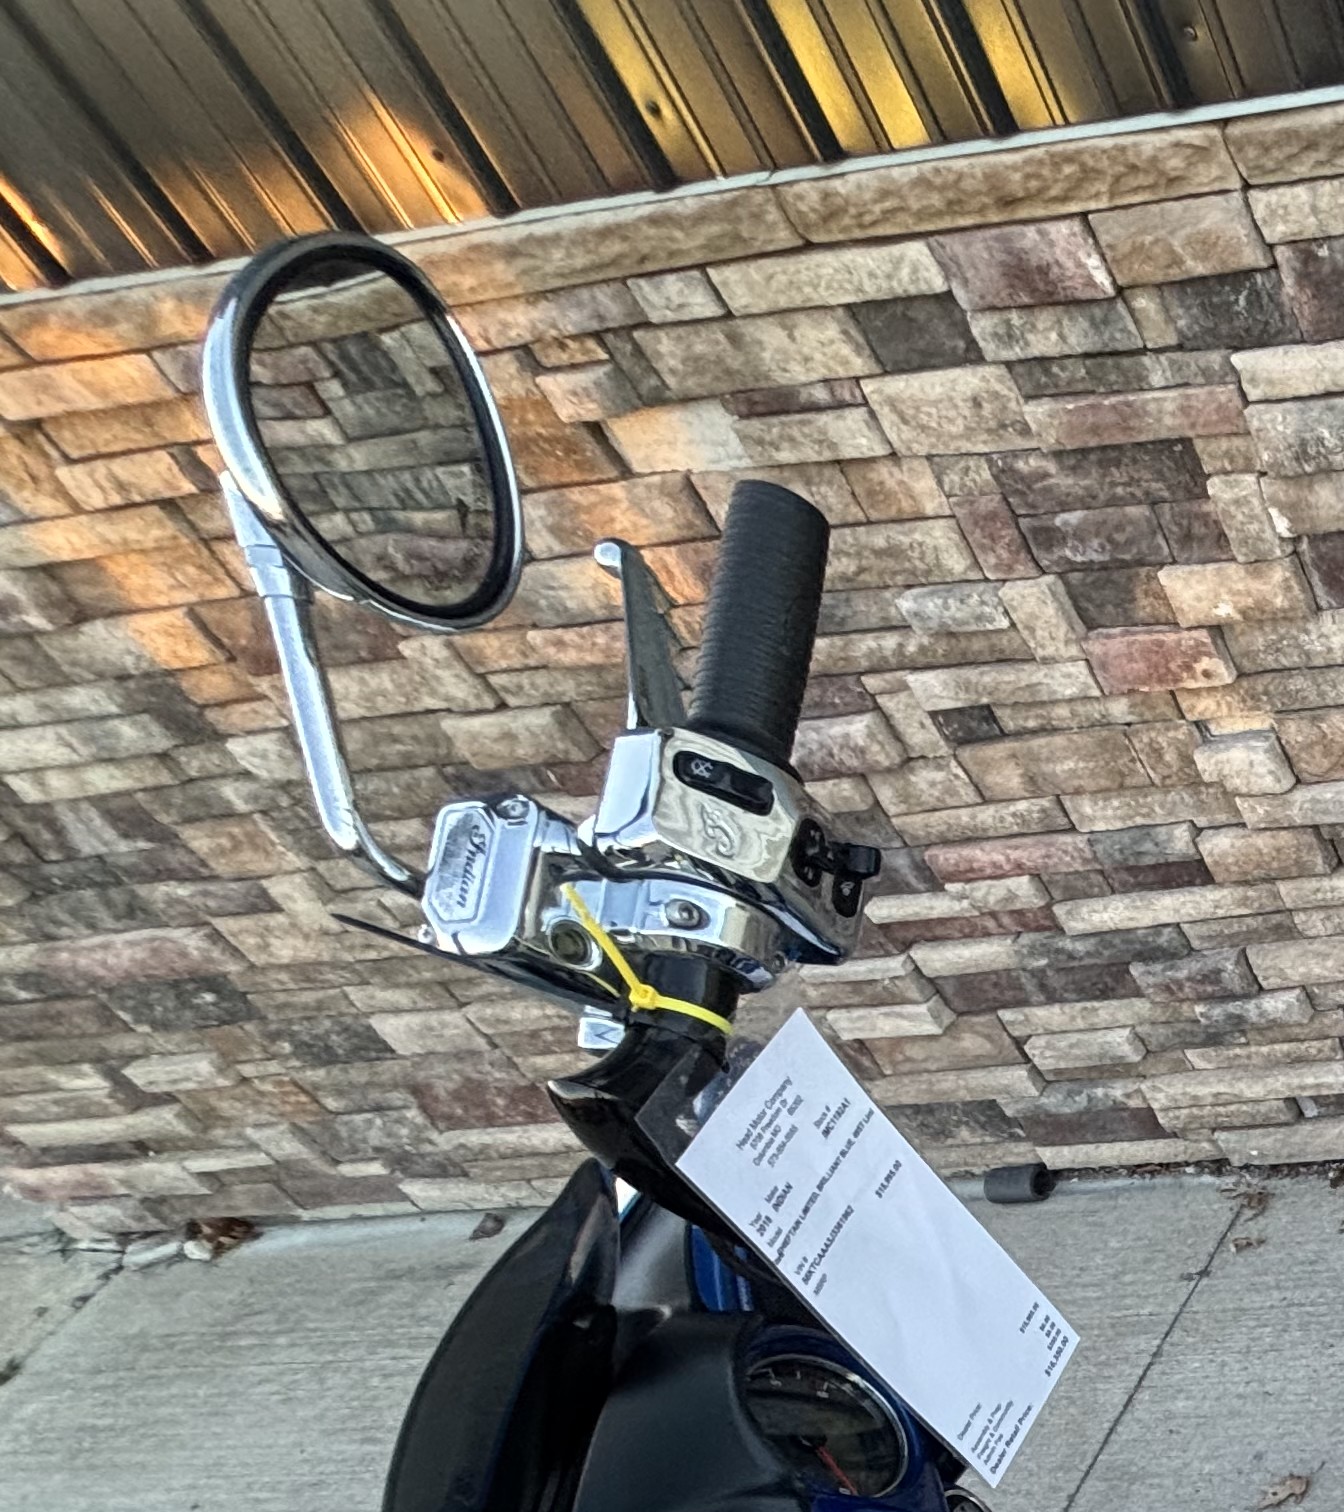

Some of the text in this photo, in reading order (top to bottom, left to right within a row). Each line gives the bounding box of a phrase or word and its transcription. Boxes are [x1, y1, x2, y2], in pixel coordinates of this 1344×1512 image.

[457, 824, 486, 908] Indian
[764, 1076, 793, 1111] Company
[749, 1212, 763, 1228] Year
[756, 1182, 794, 1238] 2018 INDIAN
[1005, 1424, 1021, 1449] Retail
